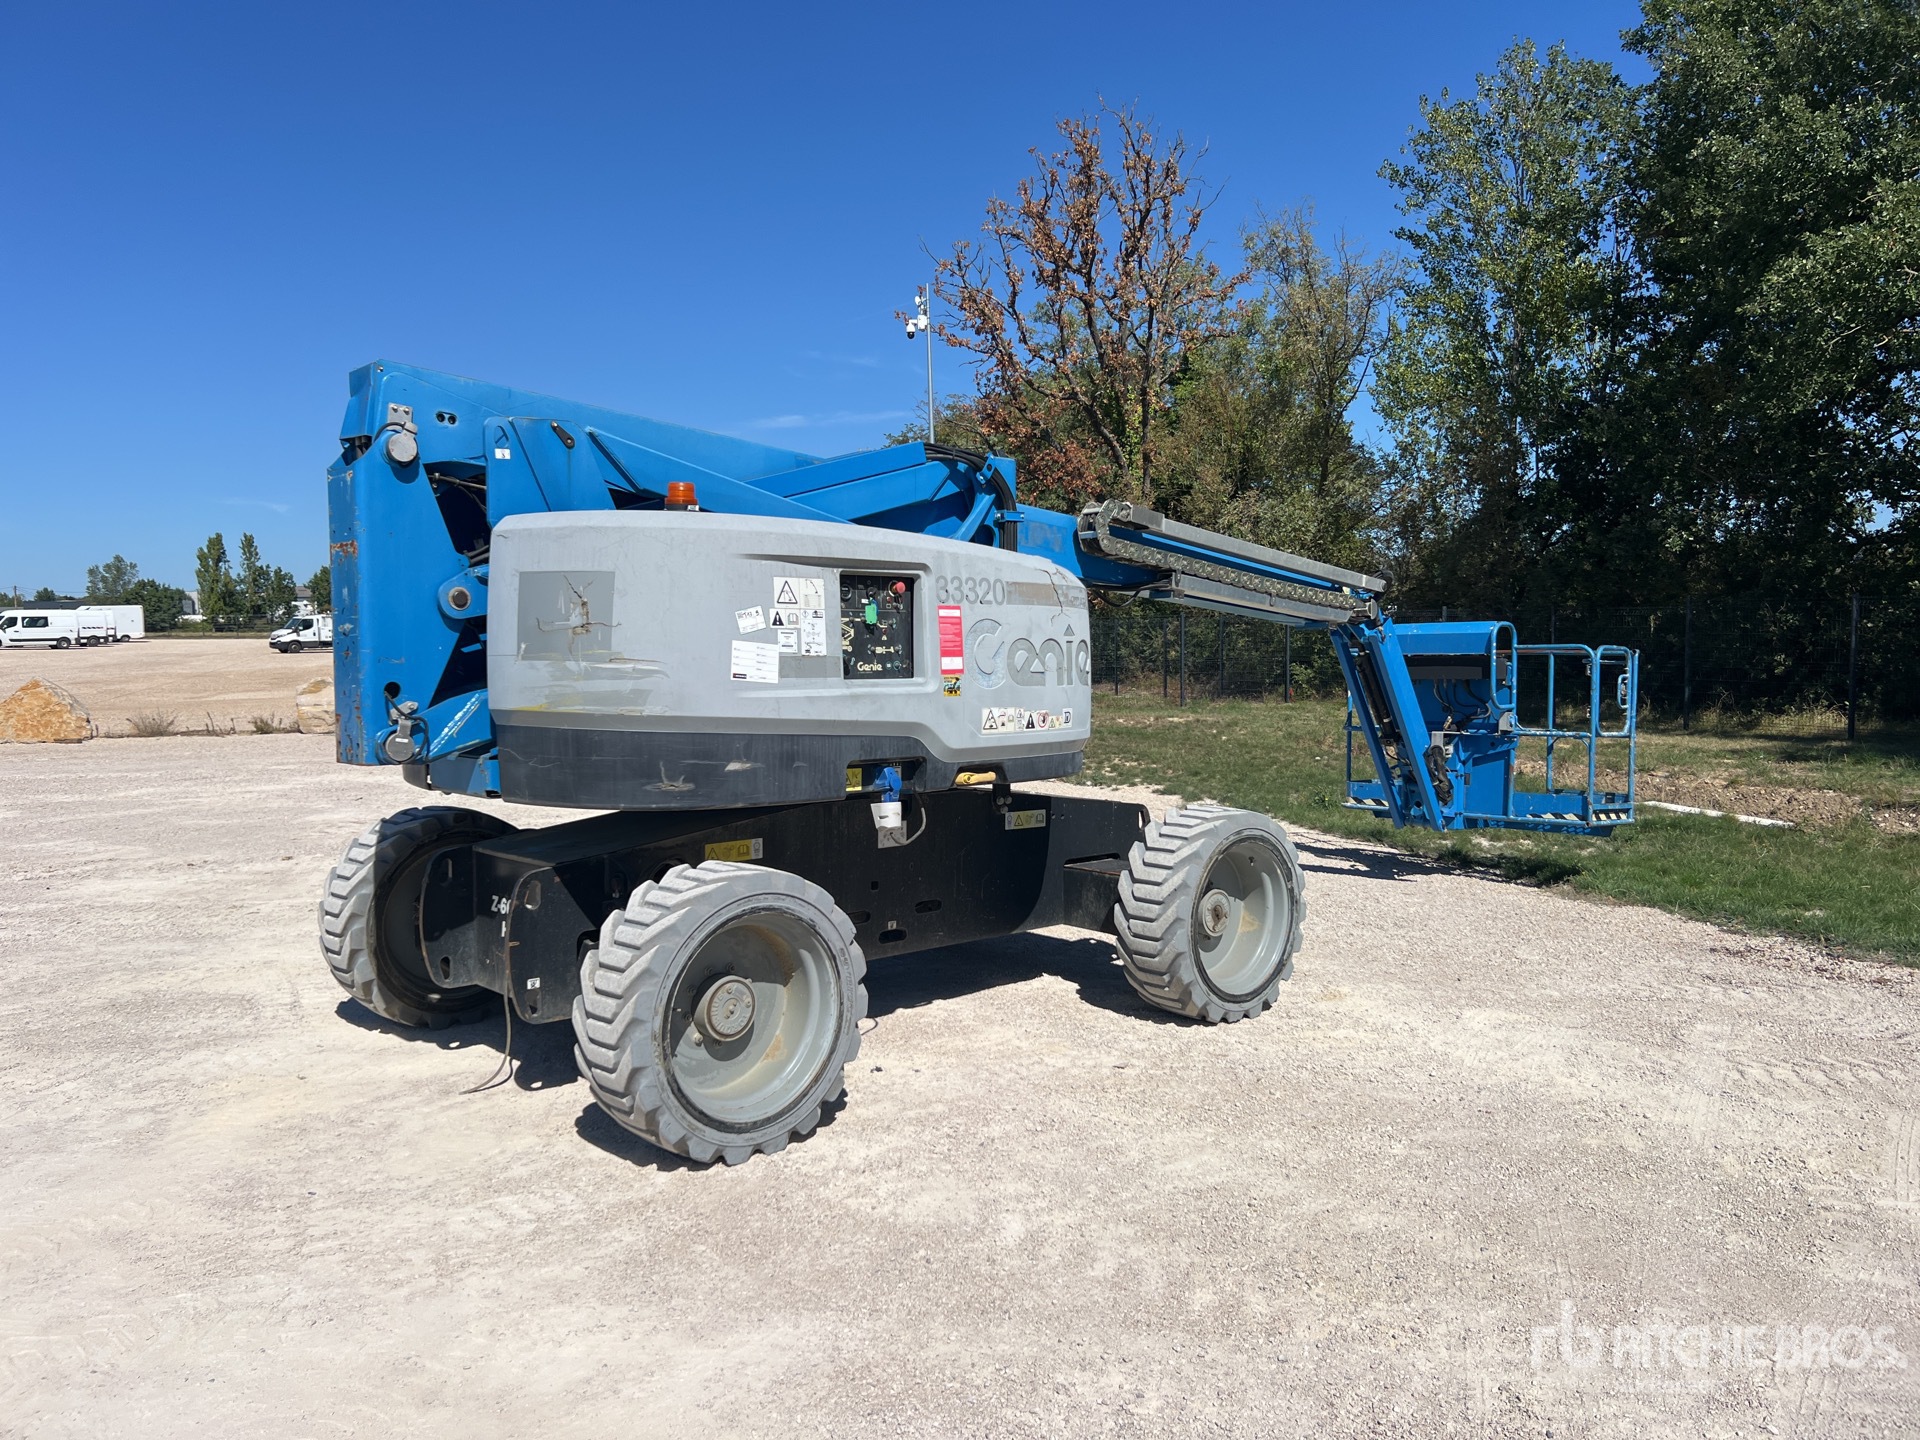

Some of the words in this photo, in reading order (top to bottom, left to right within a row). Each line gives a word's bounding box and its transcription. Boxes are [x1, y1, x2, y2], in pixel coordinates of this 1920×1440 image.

[935, 575, 1005, 606] 33320
[857, 661, 883, 672] Genie
[966, 618, 1092, 690] Genie
